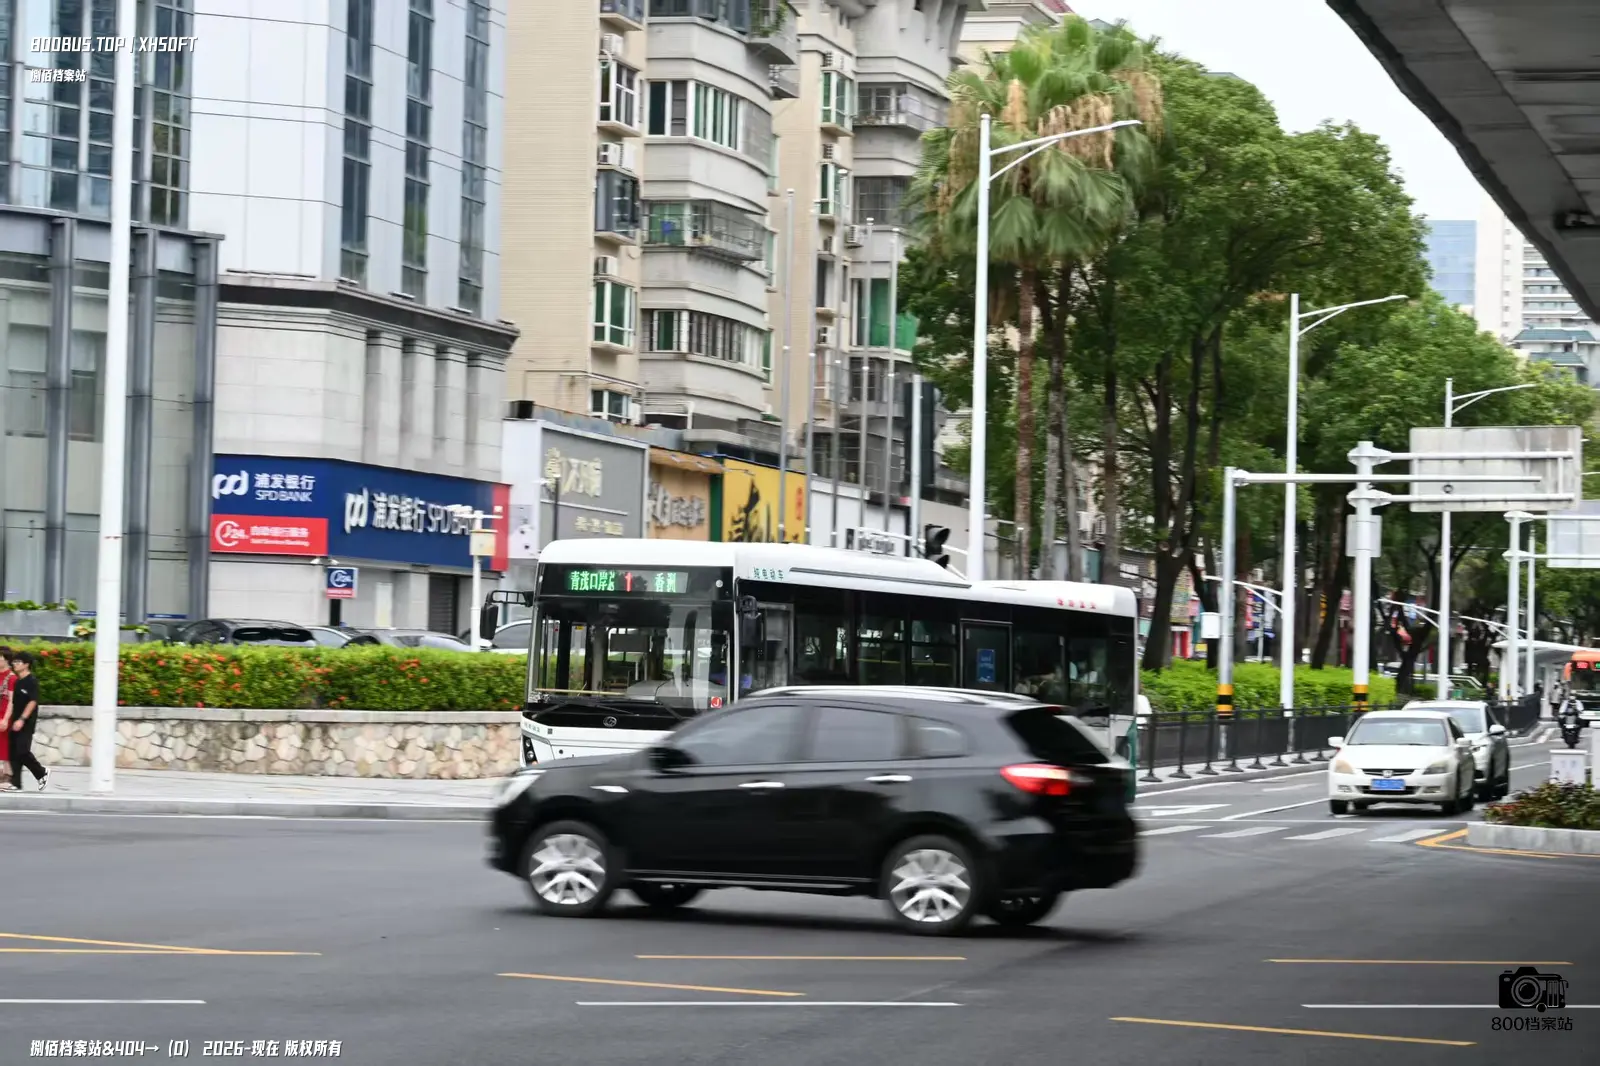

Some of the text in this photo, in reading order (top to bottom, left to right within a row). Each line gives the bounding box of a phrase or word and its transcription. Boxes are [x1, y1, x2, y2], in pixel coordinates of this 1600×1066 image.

[254, 472, 316, 490] 浦发银行
[372, 491, 427, 534] 浦发银行
[624, 571, 633, 592] 1
[655, 572, 677, 593] 香洲
